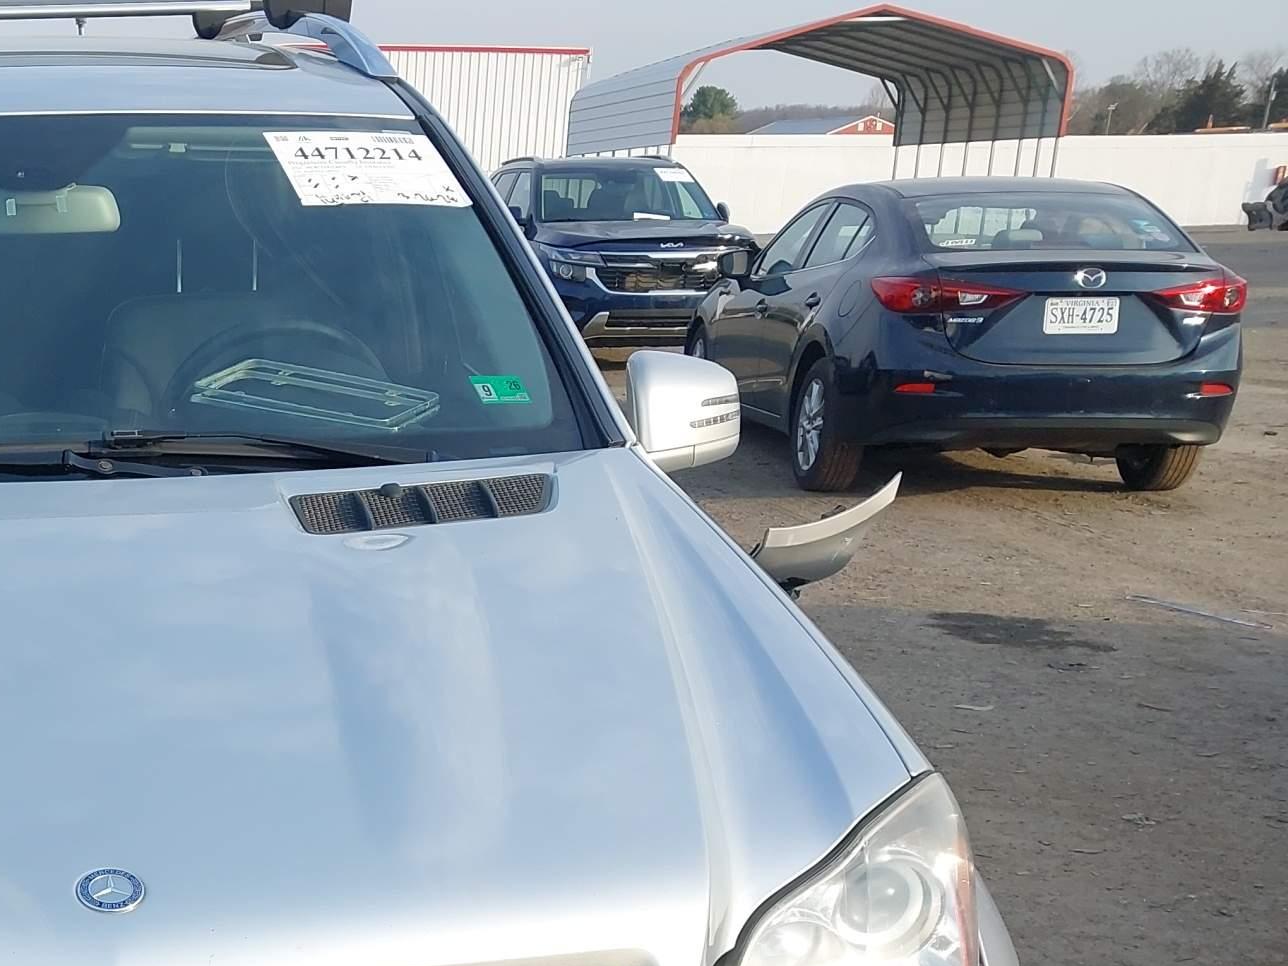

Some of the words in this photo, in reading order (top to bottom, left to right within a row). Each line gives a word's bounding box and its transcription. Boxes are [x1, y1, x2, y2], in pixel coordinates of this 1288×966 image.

[294, 146, 423, 161] 44712214
[1049, 307, 1114, 324] SXH-4725
[482, 385, 492, 397] 9
[506, 380, 521, 391] 26
